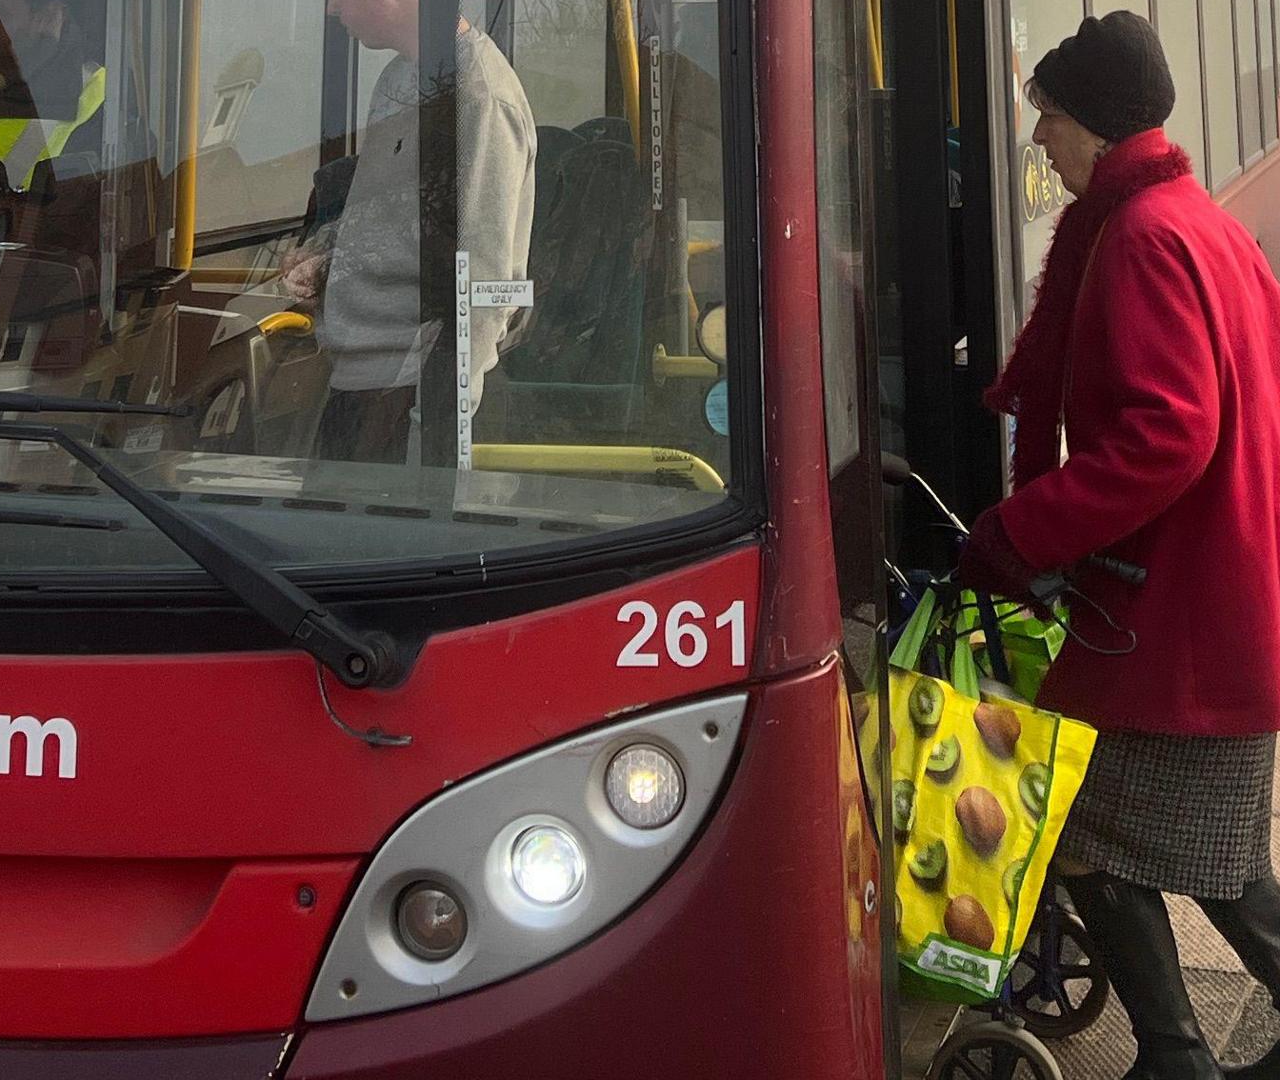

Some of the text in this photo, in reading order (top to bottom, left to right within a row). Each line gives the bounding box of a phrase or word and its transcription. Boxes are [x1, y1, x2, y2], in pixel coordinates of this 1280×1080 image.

[651, 39, 659, 100] PULL
[653, 145, 662, 206] OPEN
[458, 258, 469, 339] PUSH
[476, 284, 528, 294] EMERGENCY
[491, 295, 513, 304] ONLY
[459, 351, 469, 390] TO
[615, 600, 747, 668] 261
[932, 949, 991, 985] ASDA
